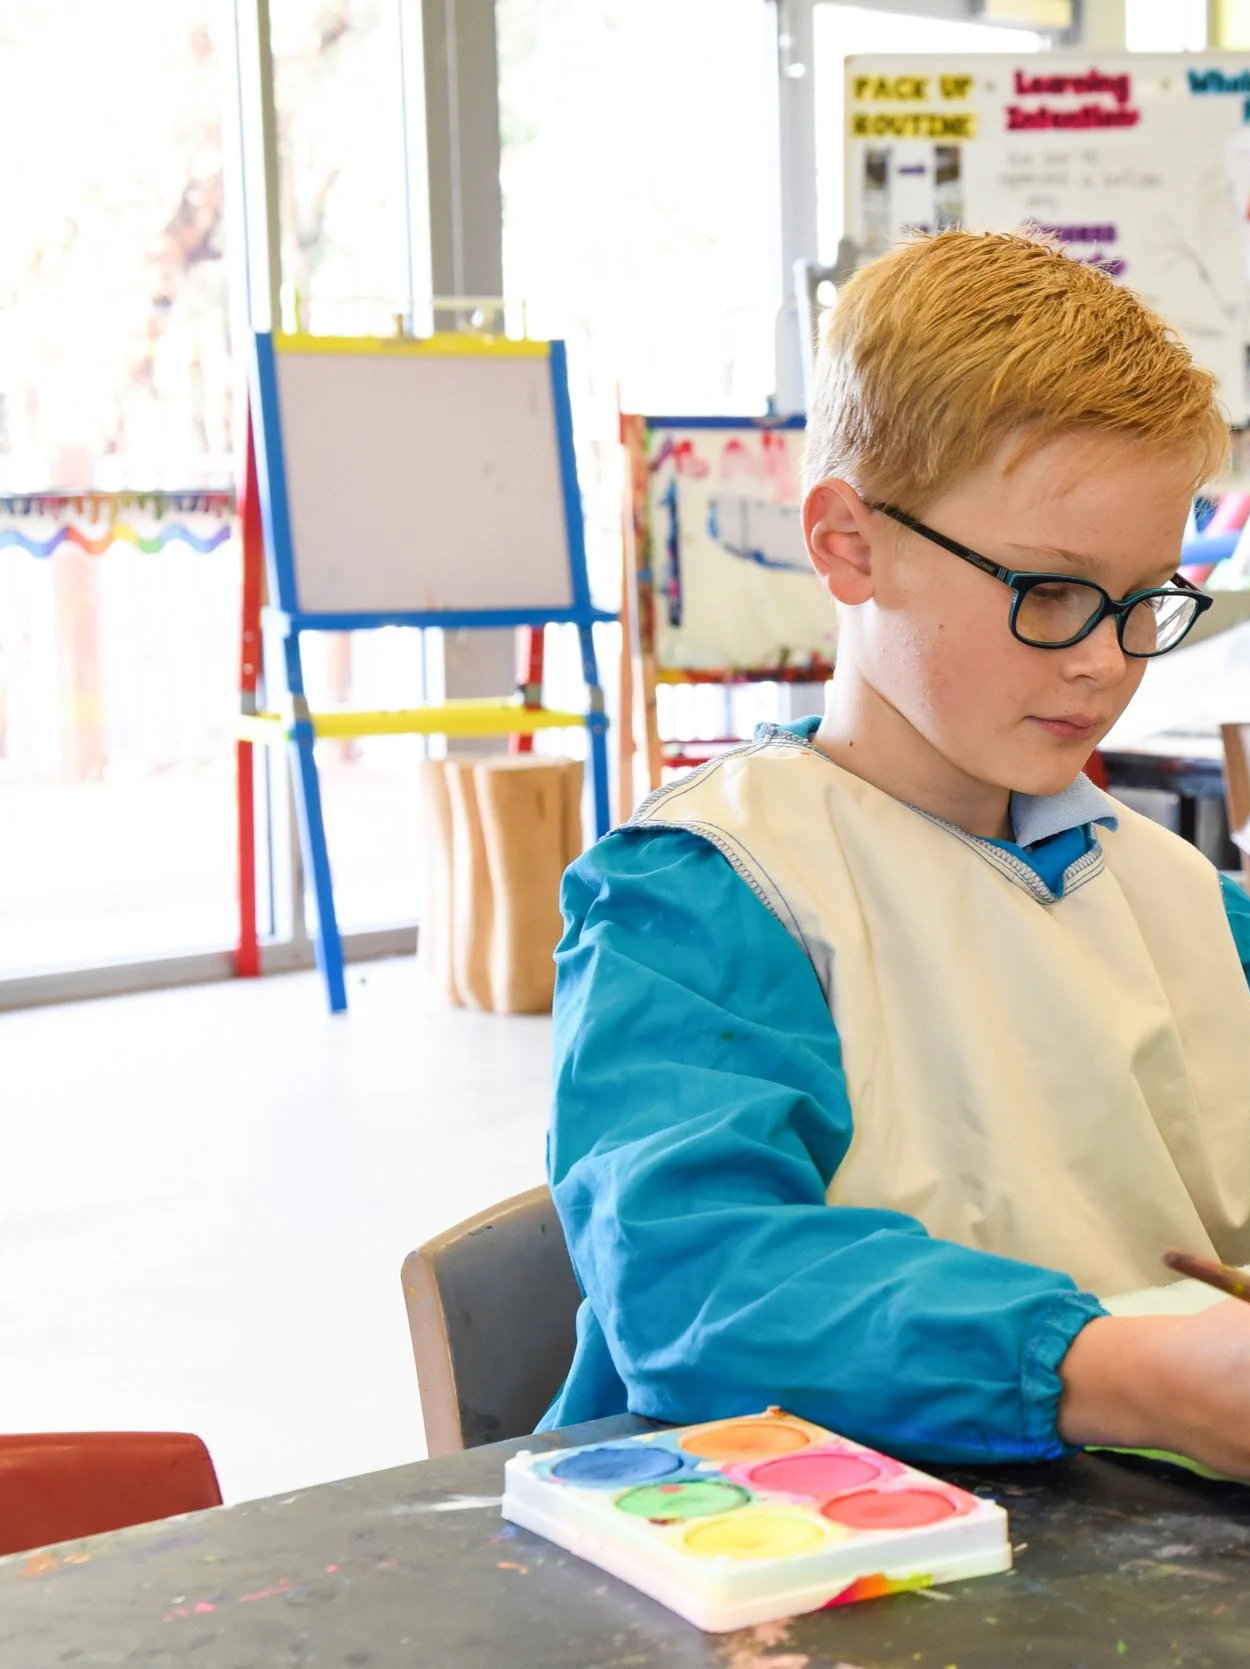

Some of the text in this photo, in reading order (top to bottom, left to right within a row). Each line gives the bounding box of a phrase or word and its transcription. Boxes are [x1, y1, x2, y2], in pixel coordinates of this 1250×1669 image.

[854, 74, 973, 100] PACK UP
[1014, 69, 1129, 105] Learning
[853, 113, 976, 136] ROUTINE
